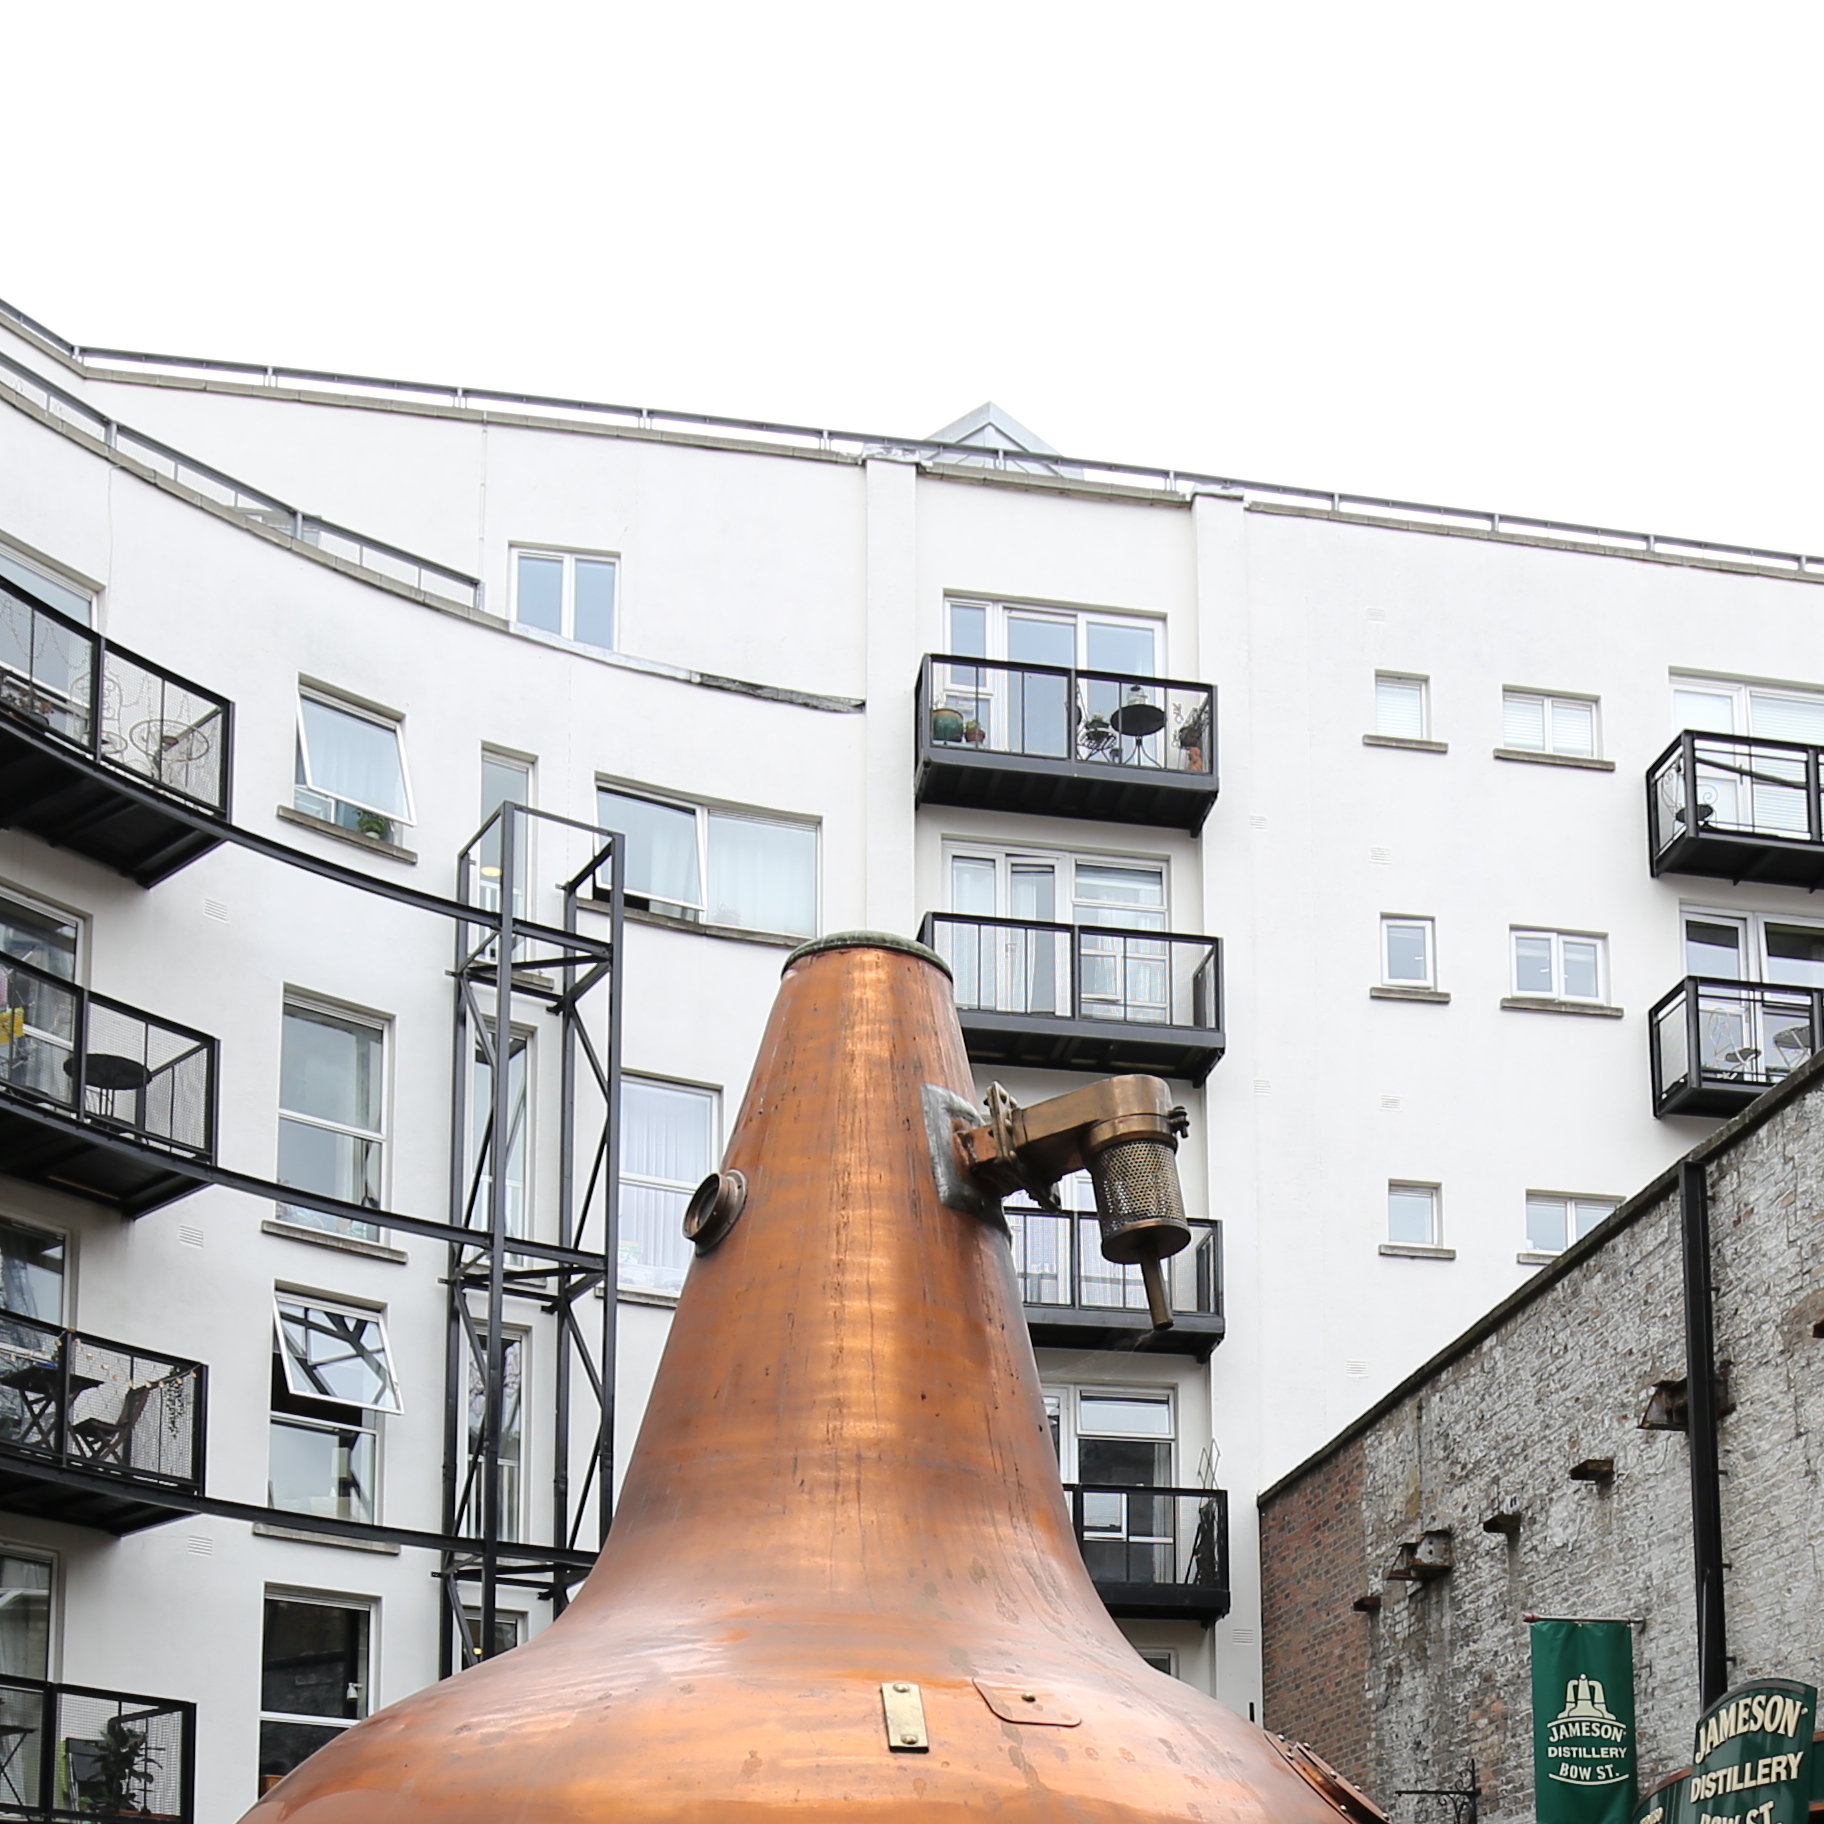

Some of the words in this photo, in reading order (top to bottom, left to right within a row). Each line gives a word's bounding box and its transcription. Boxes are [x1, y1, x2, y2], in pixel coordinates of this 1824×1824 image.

[1548, 1722, 1625, 1742] JAMESON
[1695, 1694, 1806, 1764] JAMESON
[1547, 1746, 1627, 1758] DISTILLERY
[1559, 1762, 1592, 1780] BOW
[1596, 1764, 1620, 1780] ST.
[1690, 1751, 1804, 1803] DISTILLERY
